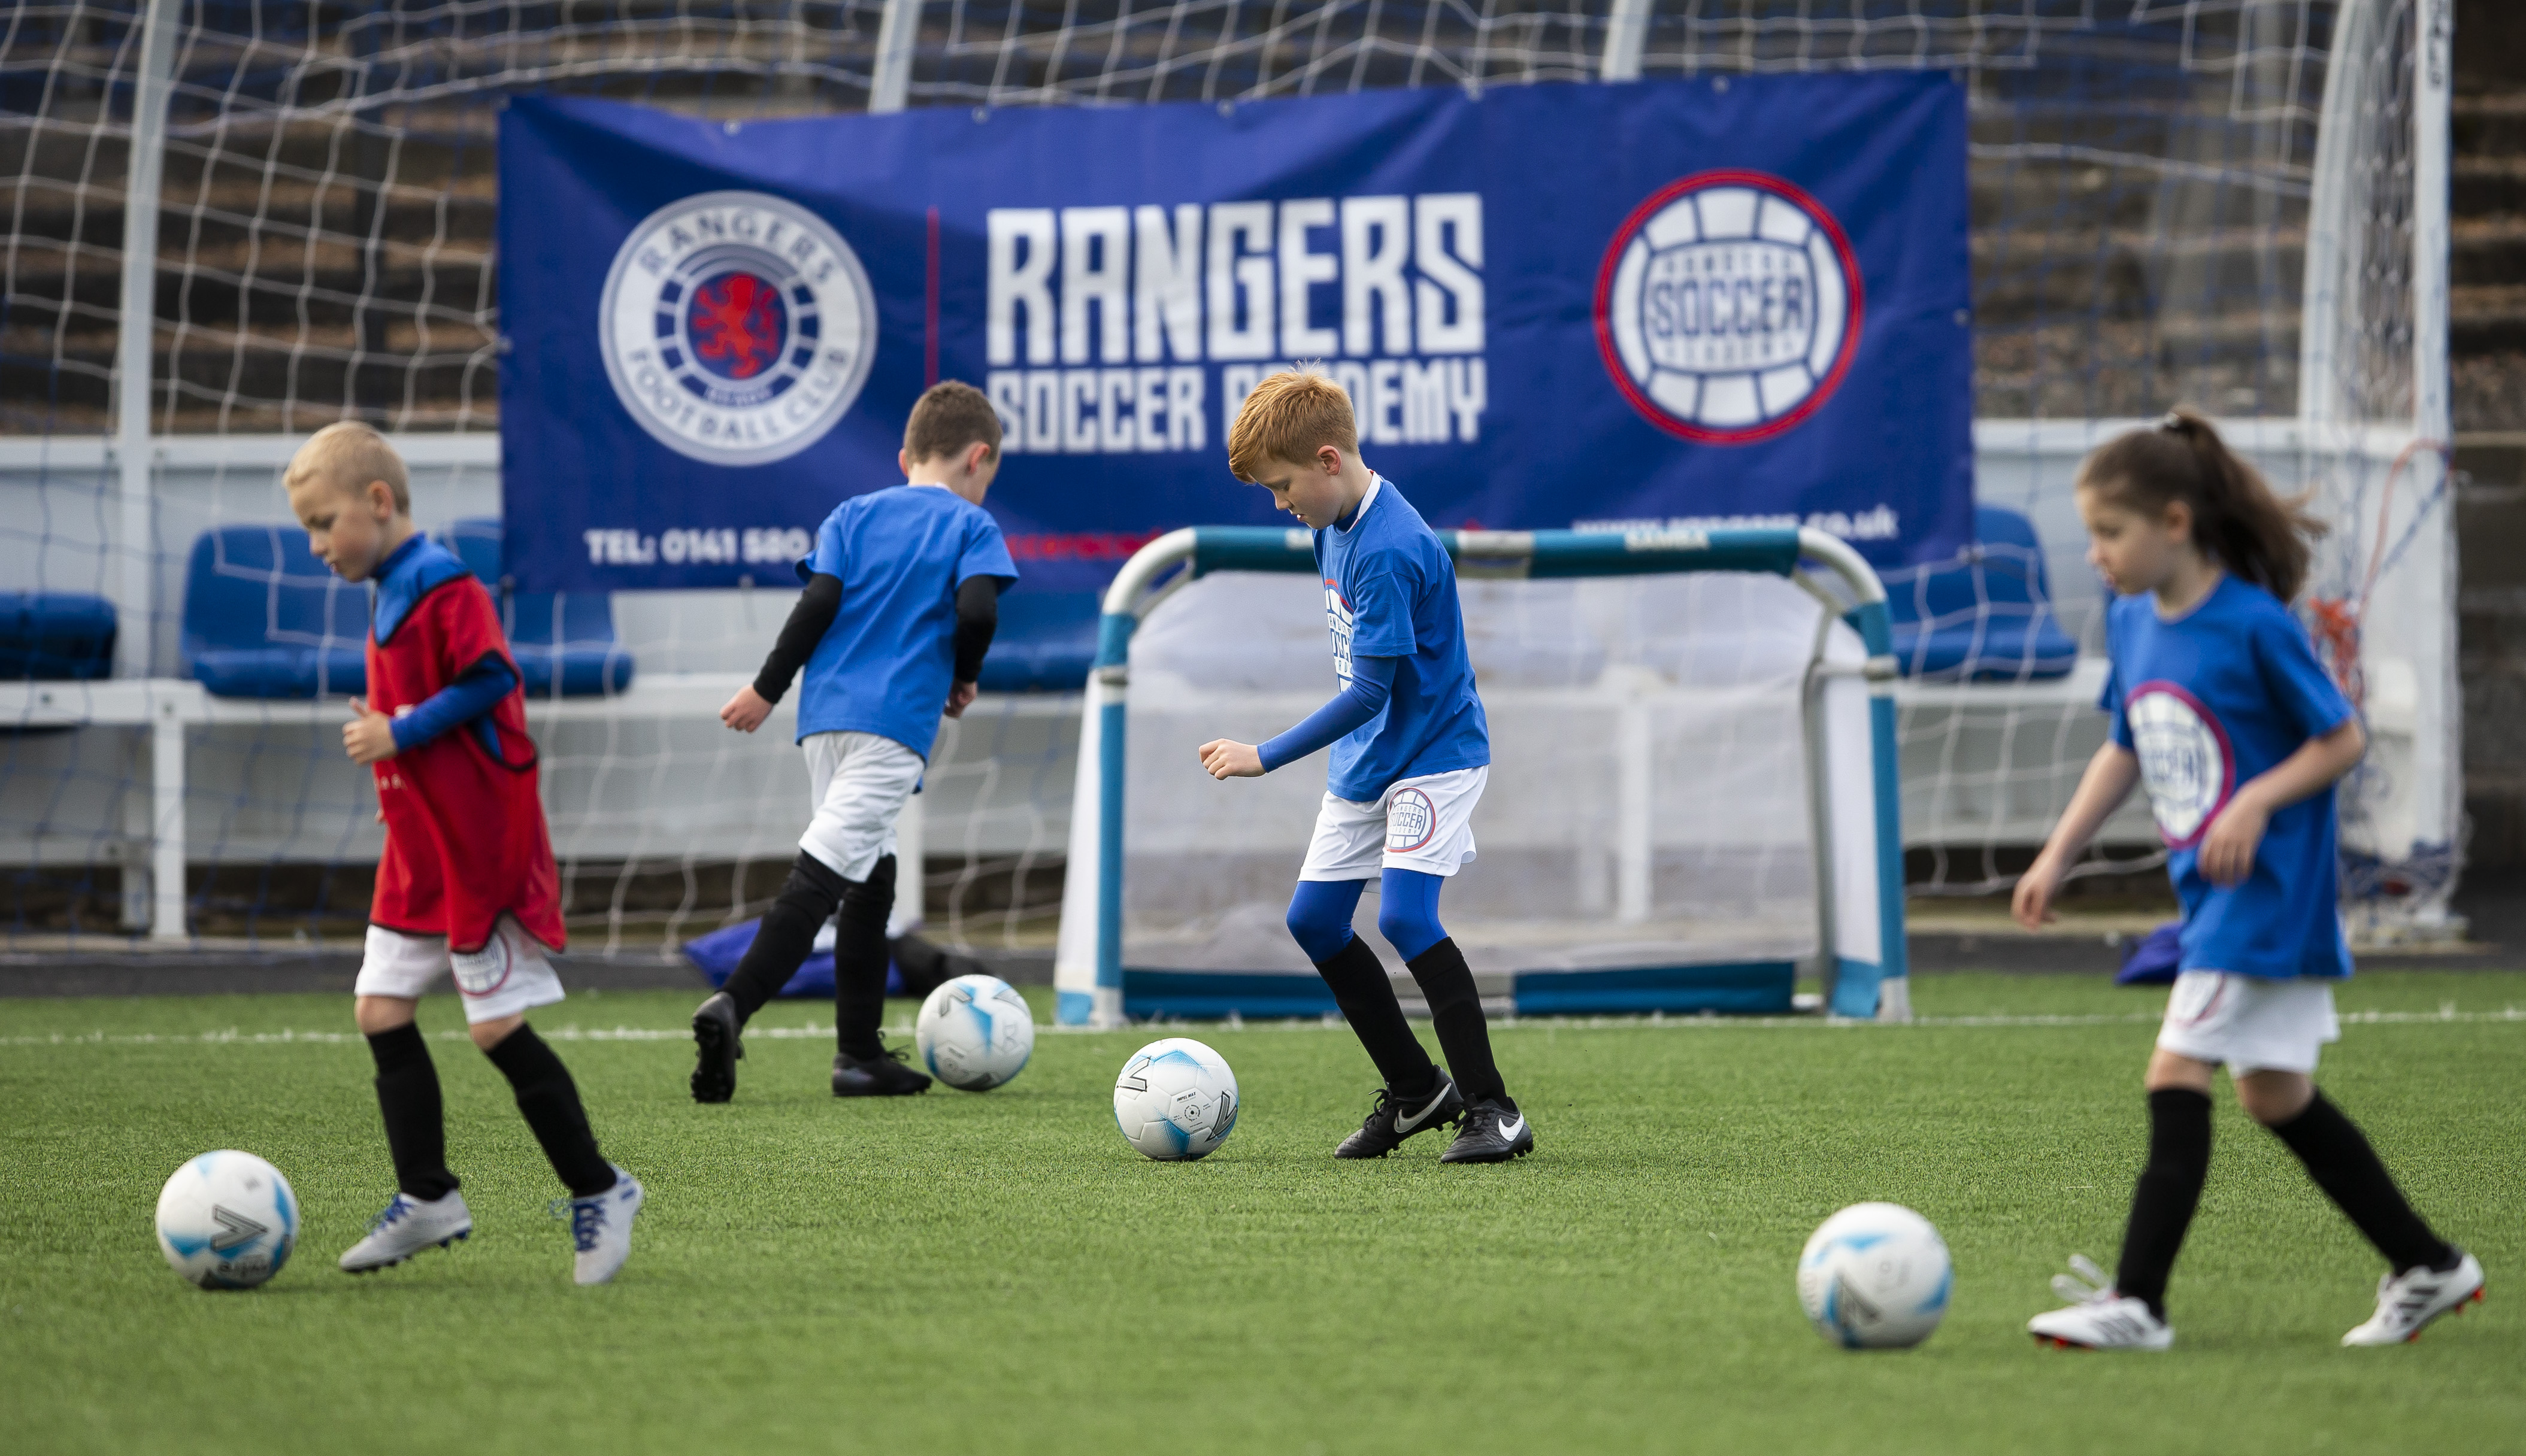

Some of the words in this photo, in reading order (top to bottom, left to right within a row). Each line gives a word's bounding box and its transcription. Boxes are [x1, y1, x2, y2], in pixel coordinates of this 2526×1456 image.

[637, 207, 835, 287] RANGERS
[986, 193, 1486, 366] RANGERS
[1653, 275, 1804, 338] SOCCER
[626, 346, 782, 443] FOOTBALL
[783, 345, 852, 423] CLUB
[987, 364, 1206, 455] SOCCER
[1223, 357, 1487, 446] ADEMY
[582, 527, 657, 566] TEL:
[1389, 812, 1423, 830] SOCCER
